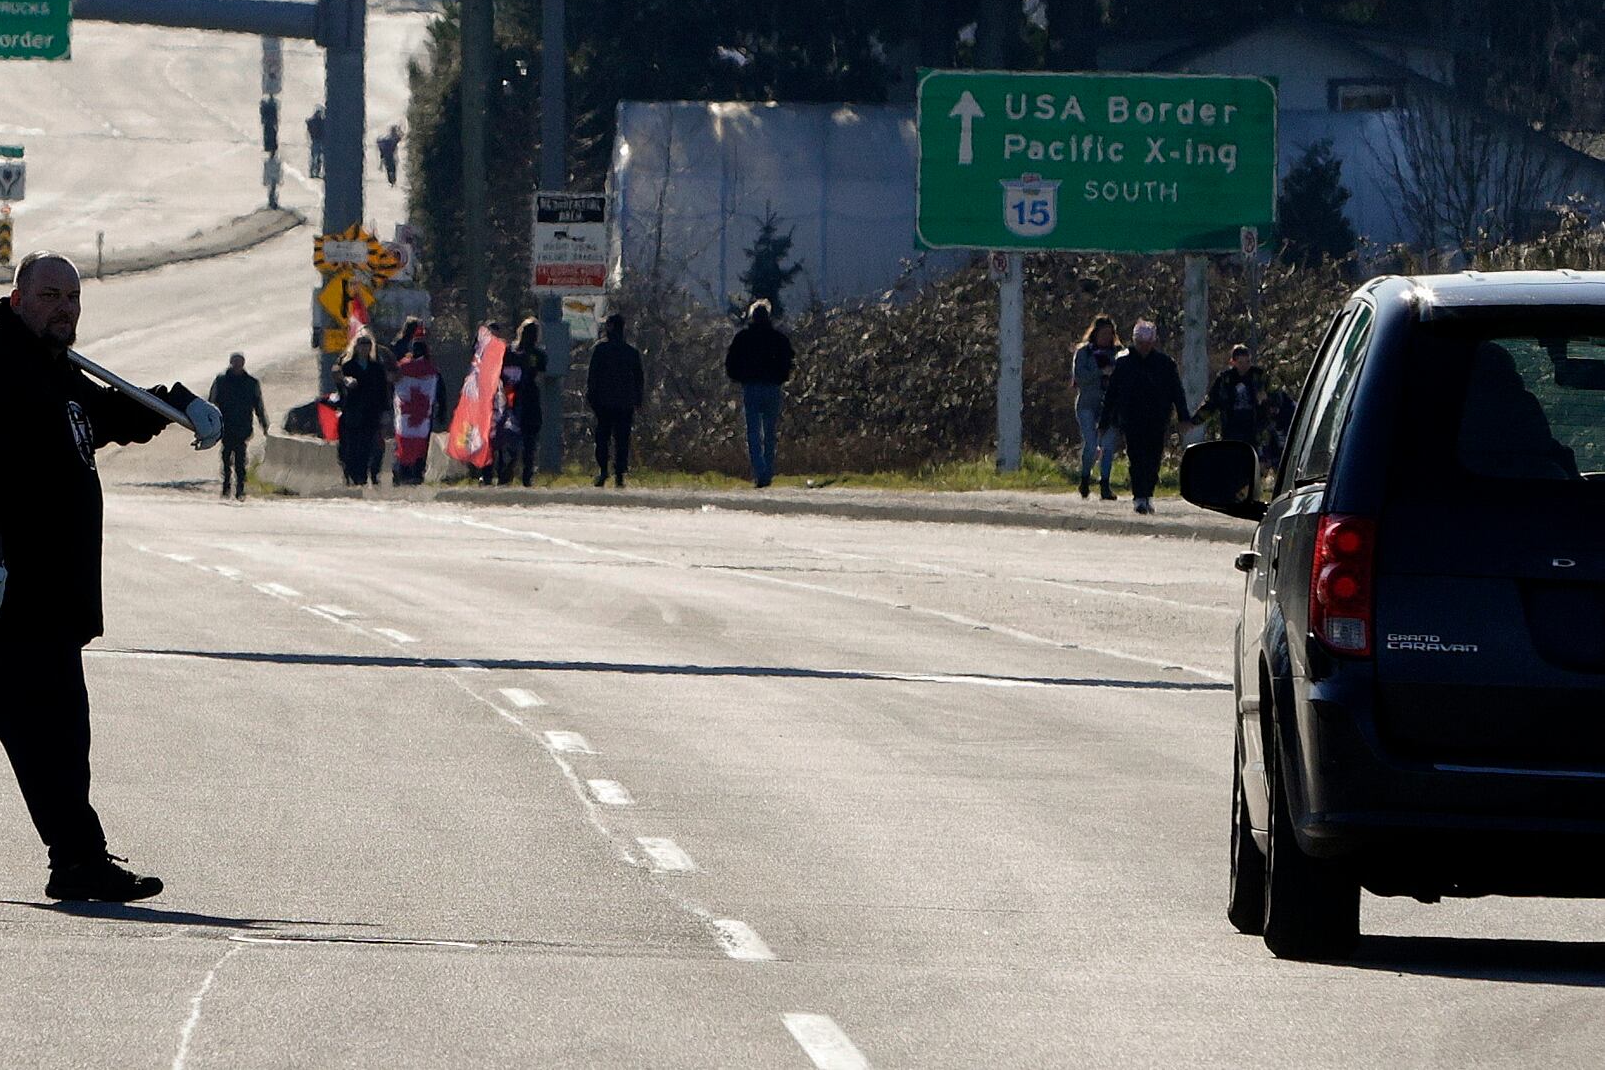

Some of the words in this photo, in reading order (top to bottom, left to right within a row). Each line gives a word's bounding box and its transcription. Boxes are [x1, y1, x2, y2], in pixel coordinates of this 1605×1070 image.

[1004, 93, 1085, 123] USA
[1107, 95, 1238, 125] Border
[1004, 134, 1124, 163] Pacific
[1083, 180, 1178, 203] SOUTH
[1012, 201, 1051, 228] 15
[1387, 633, 1440, 643] GRAND
[1387, 642, 1479, 652] CARAVAN
